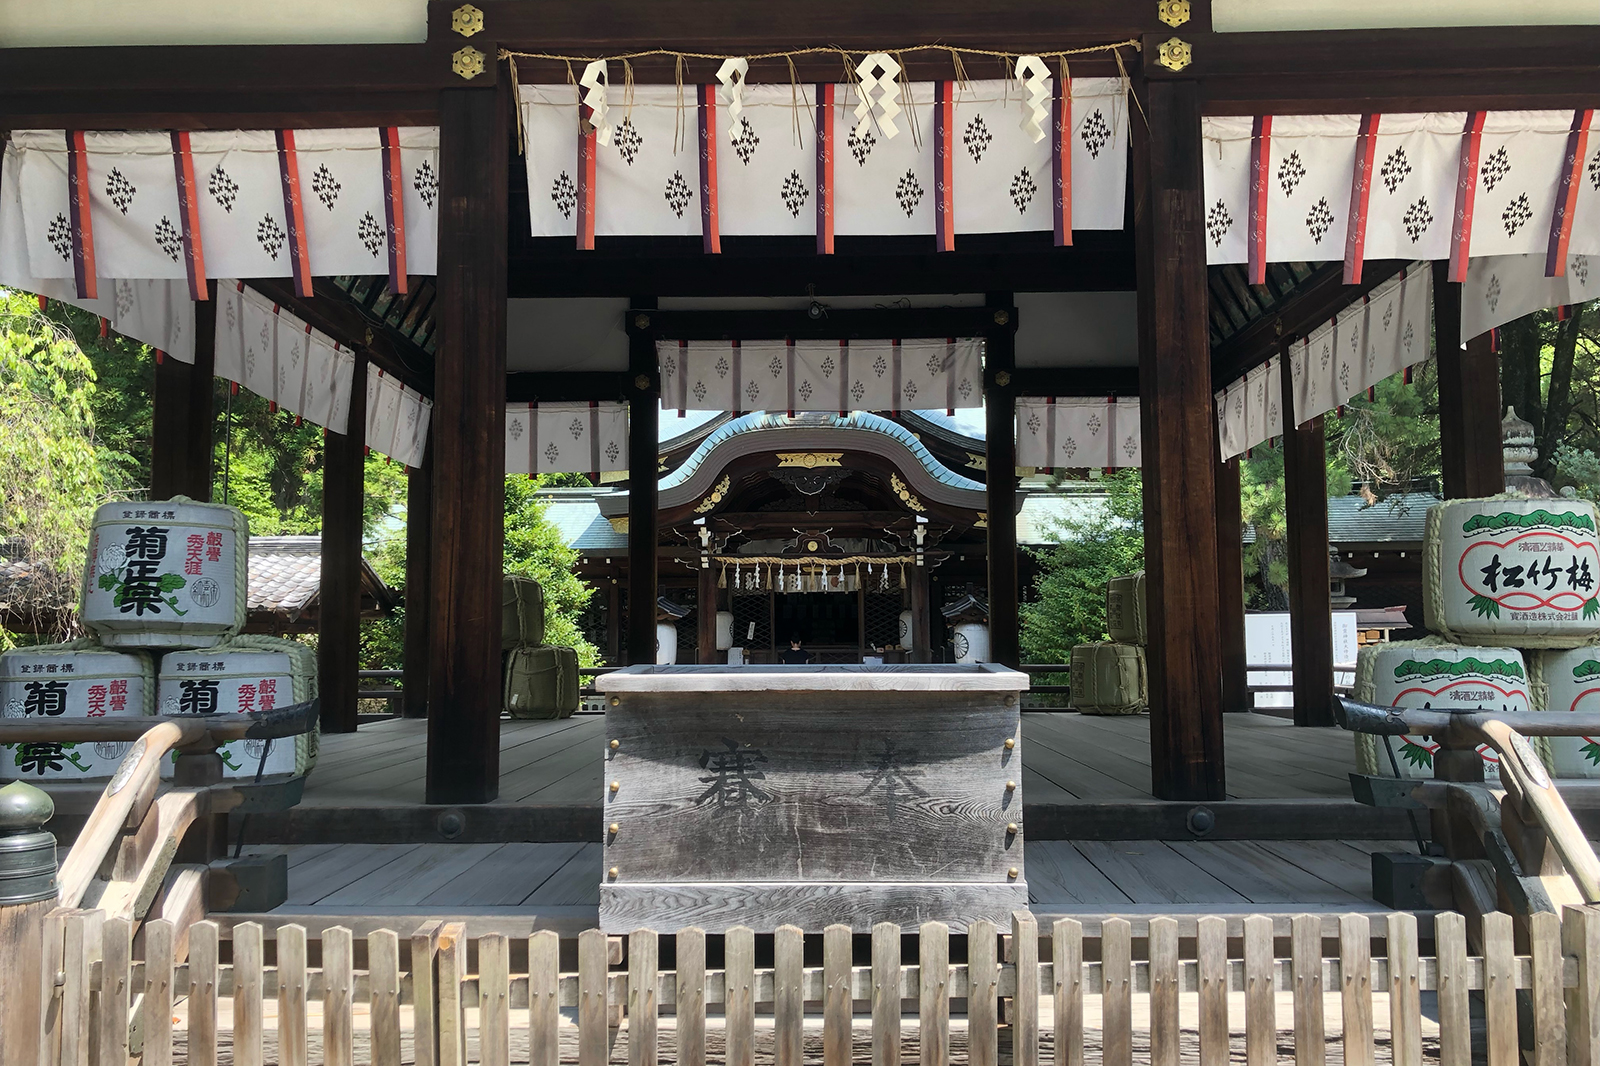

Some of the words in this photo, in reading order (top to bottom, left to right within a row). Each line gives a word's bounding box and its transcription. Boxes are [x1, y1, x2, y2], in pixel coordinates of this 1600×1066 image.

[120, 526, 170, 616] 菊正宗
[1480, 553, 1594, 593] 松竹梅
[87, 685, 108, 718] 秀天
